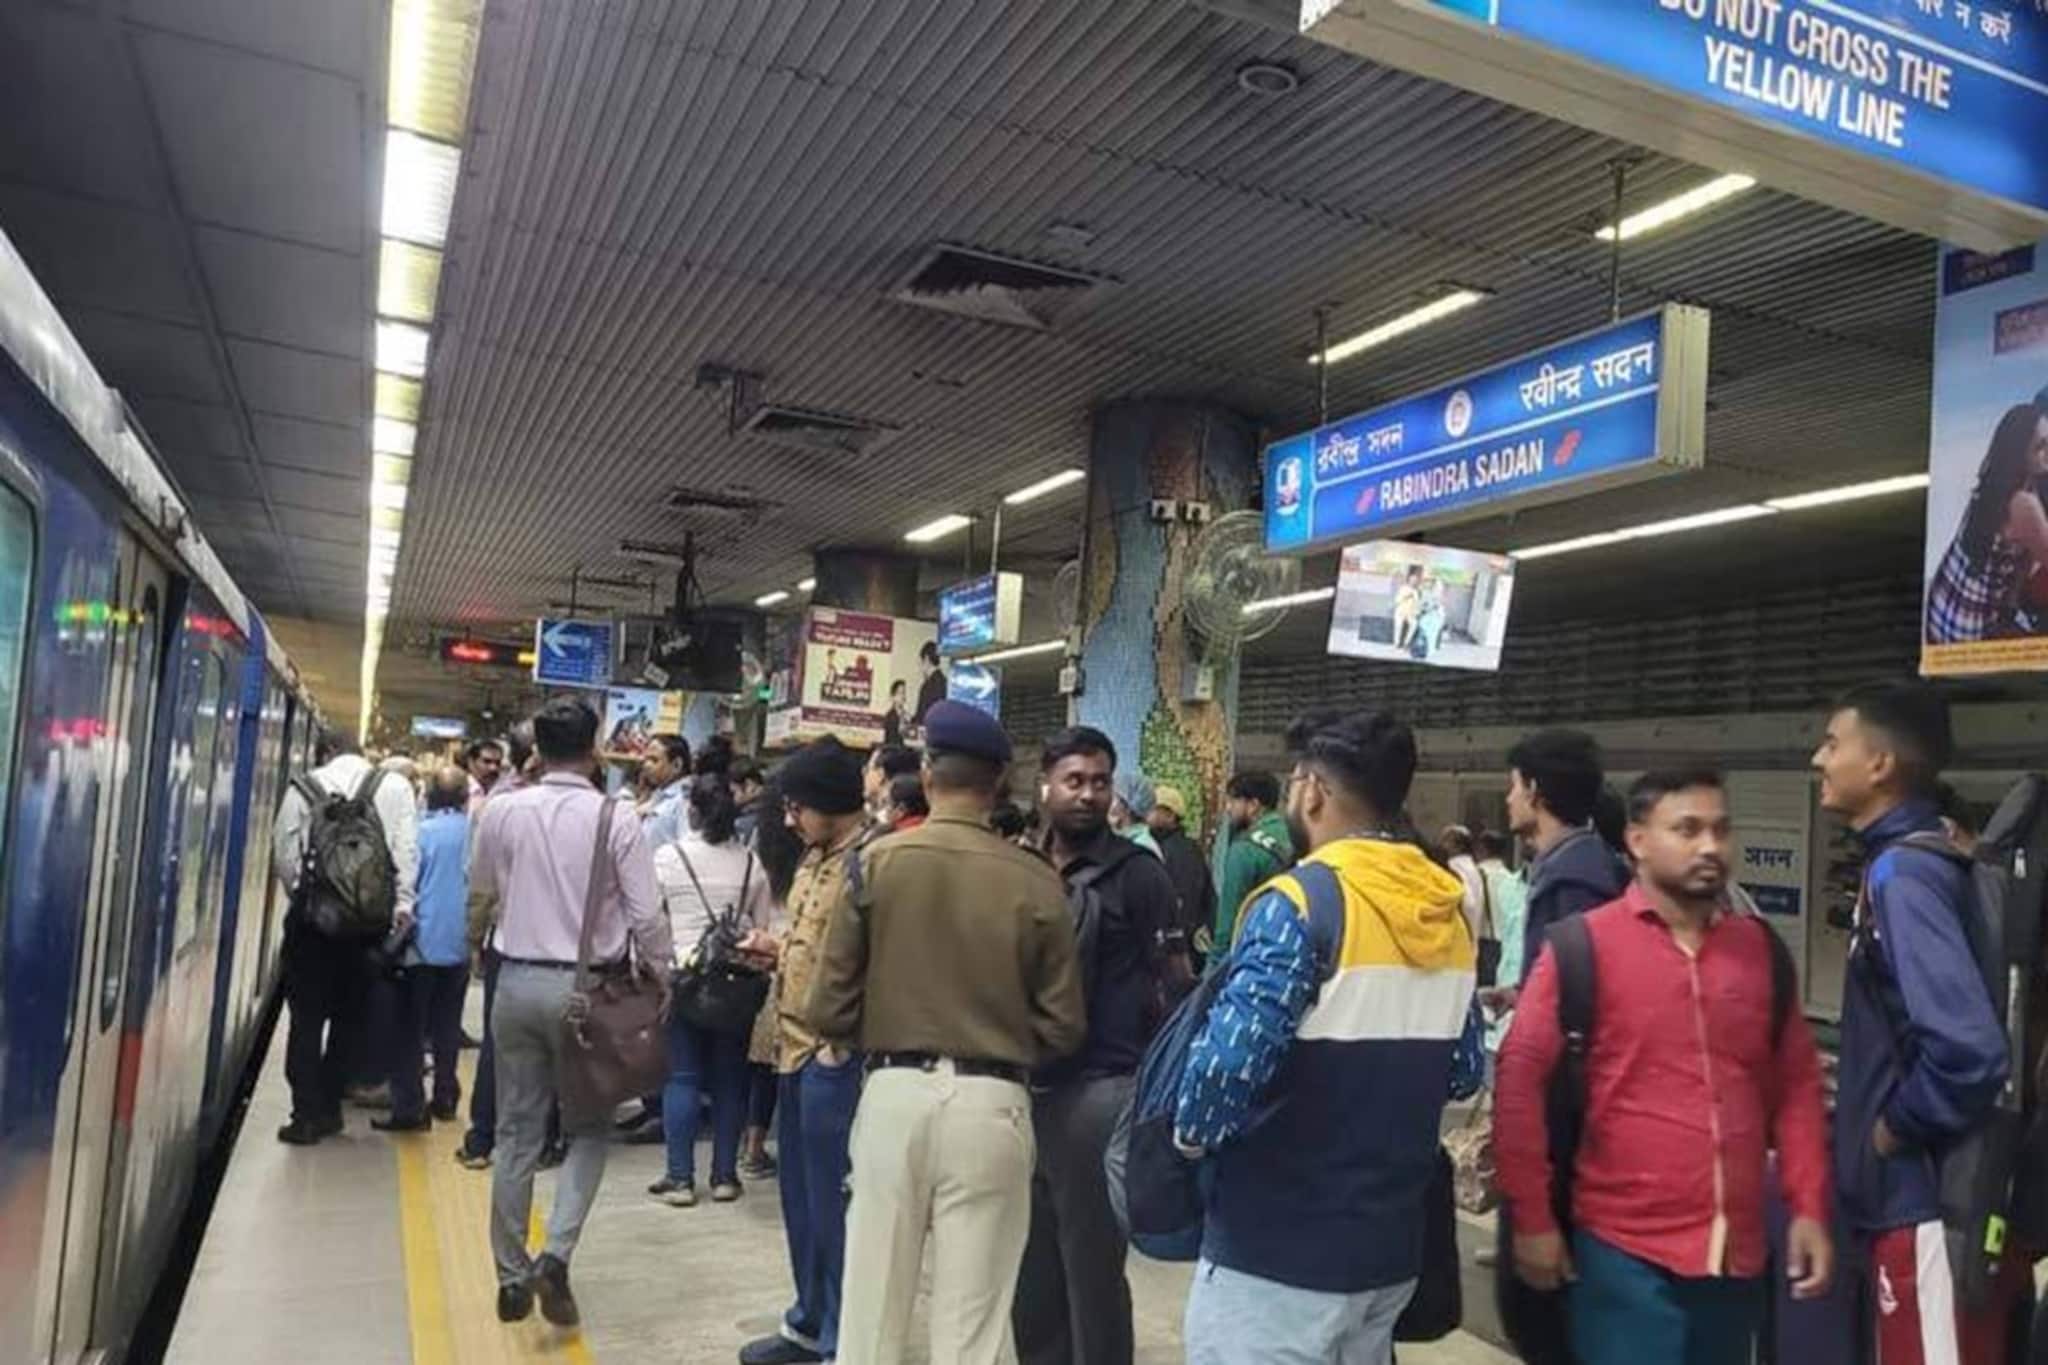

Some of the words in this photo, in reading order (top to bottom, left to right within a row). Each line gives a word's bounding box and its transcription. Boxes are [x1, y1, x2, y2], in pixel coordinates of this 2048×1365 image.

[1704, 35, 1835, 122] YELLOW
[1837, 84, 1906, 148] LINE
[1787, 9, 1890, 86] CROSS
[1896, 49, 1953, 110] THE
[1519, 362, 1584, 411] रवीन्द्र
[1591, 340, 1655, 389] सदन
[1379, 458, 1469, 512] RABINDRA
[1474, 438, 1544, 488] SADAN
